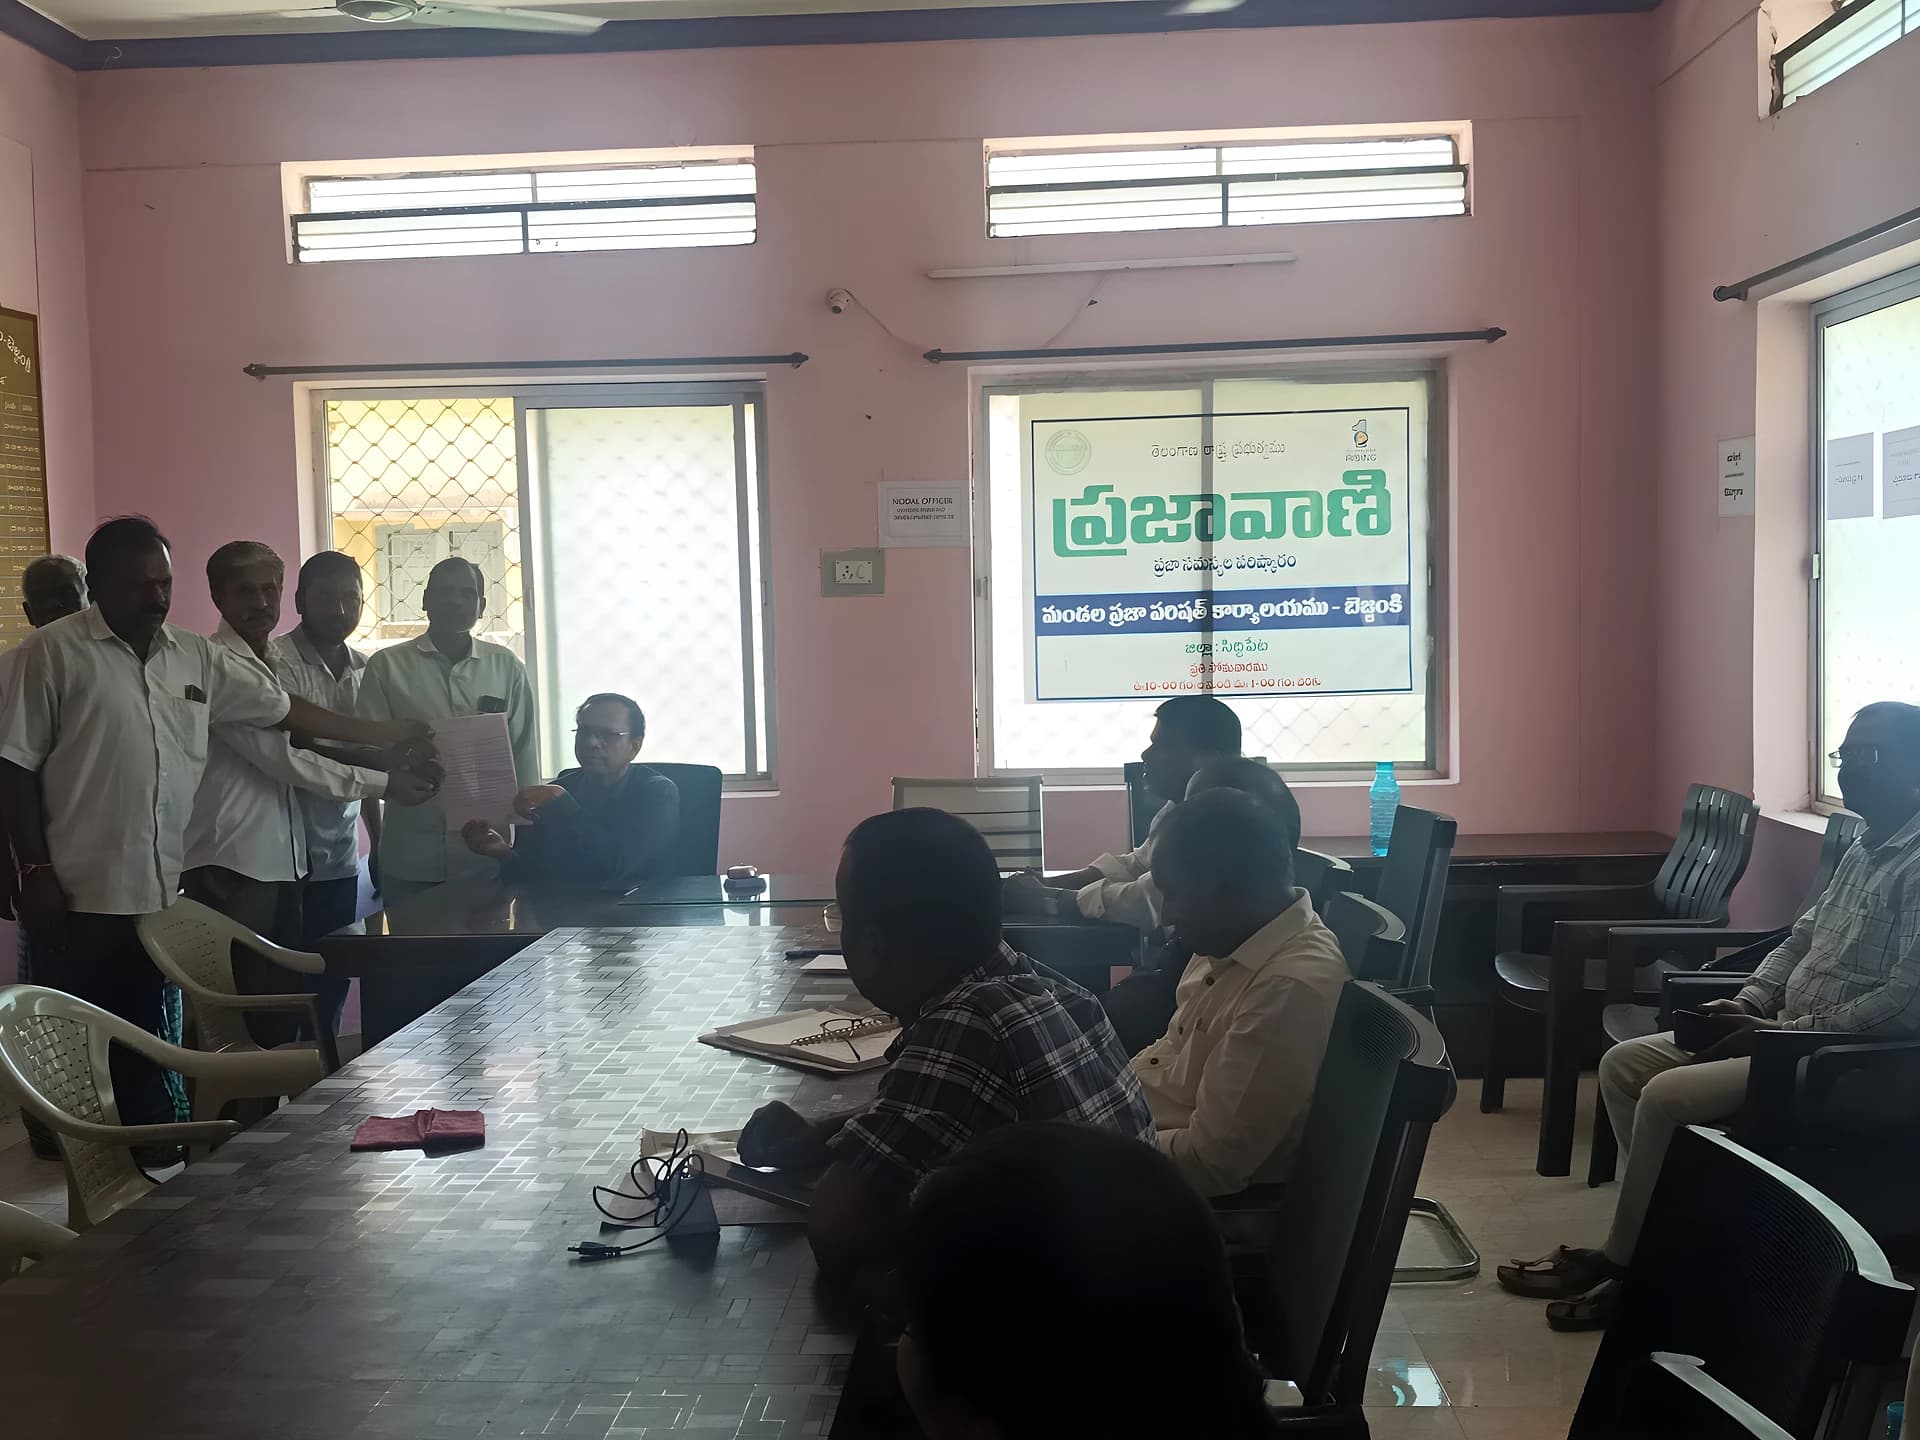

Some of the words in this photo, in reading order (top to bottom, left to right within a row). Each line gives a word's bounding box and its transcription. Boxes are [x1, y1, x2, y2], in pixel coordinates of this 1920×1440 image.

[1052, 468, 1392, 557] ప్రజావాణి
[1154, 557, 1180, 577] ప్రజా
[1182, 556, 1233, 577] సమస్యల
[1235, 554, 1297, 573] పరిష్కారం
[1042, 604, 1106, 624] మండల
[1108, 602, 1147, 627] ప్రజా
[1149, 598, 1208, 623] పరిషత్
[1212, 596, 1329, 625] కార్యాలయము
[1344, 593, 1403, 623] బెజ్జంకి
